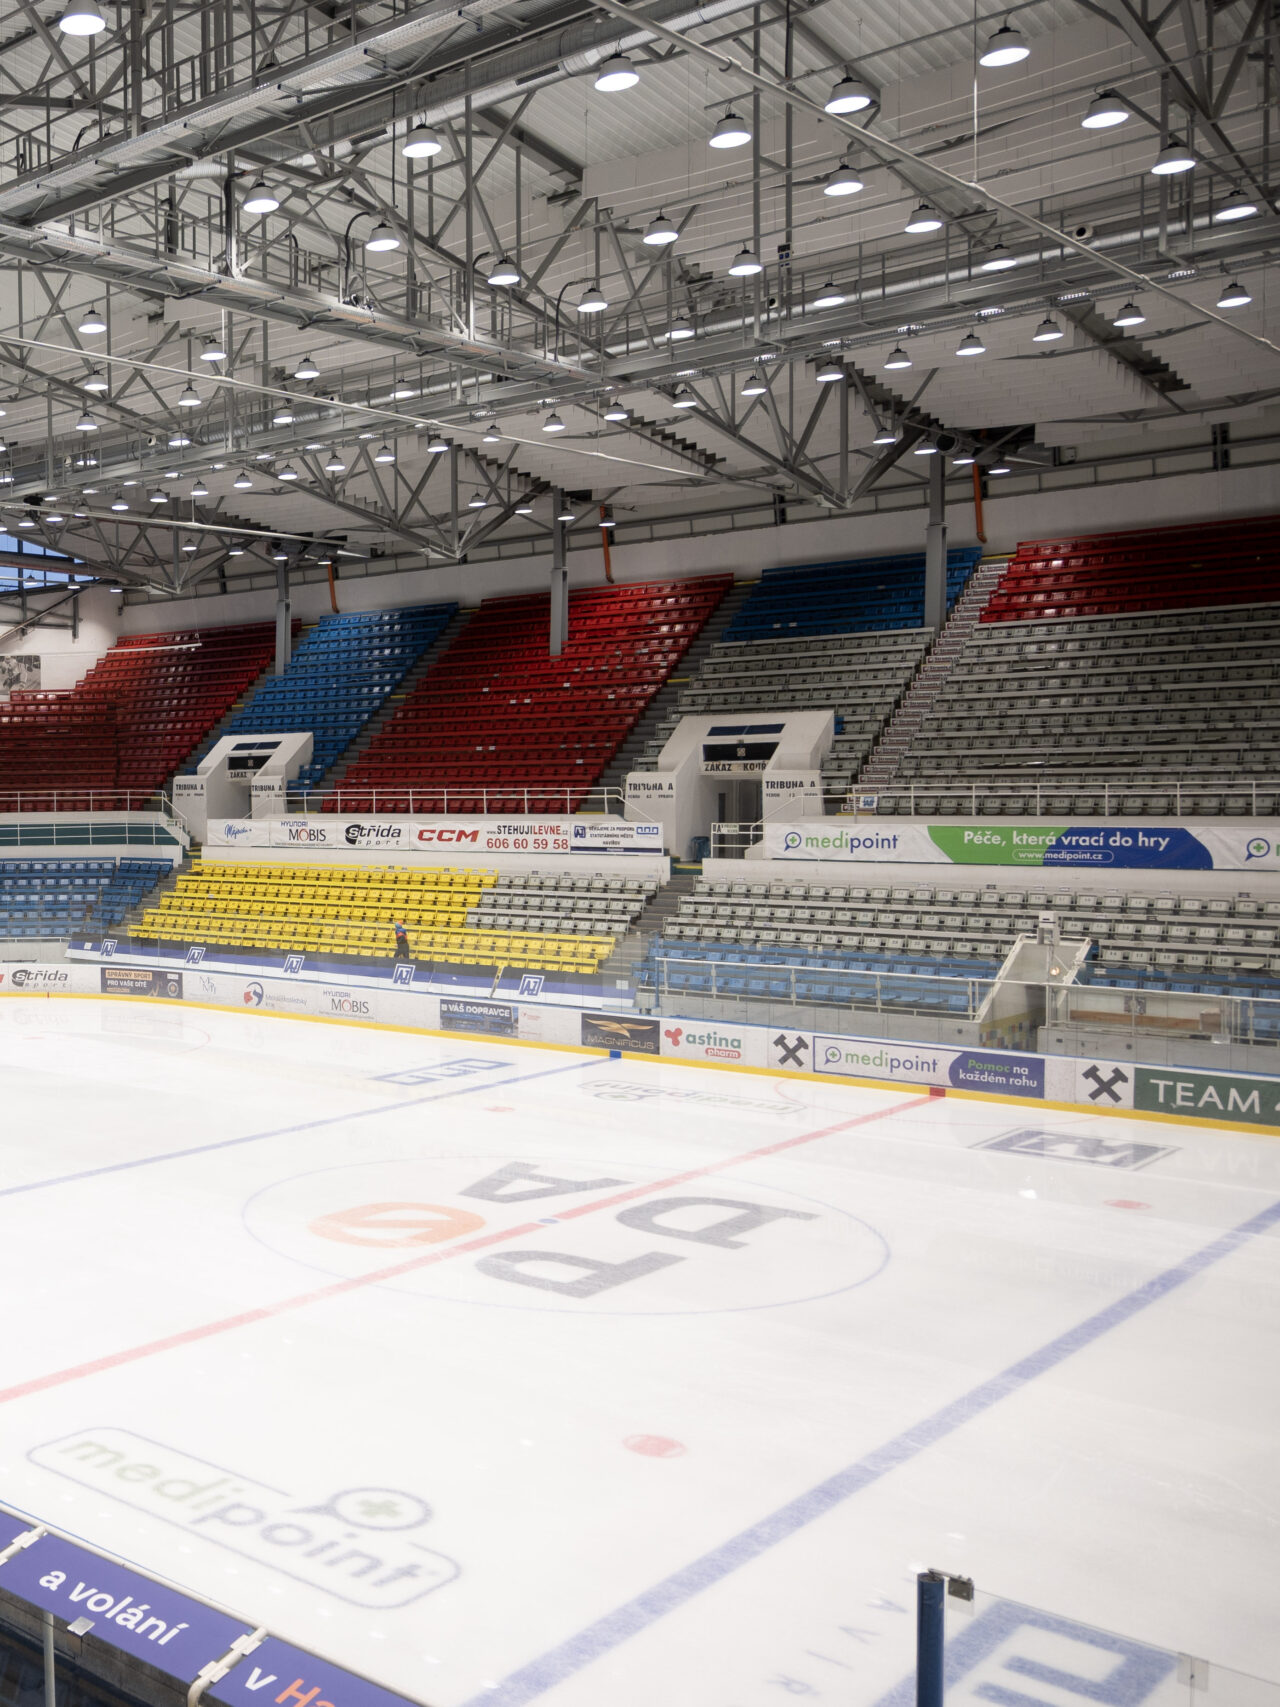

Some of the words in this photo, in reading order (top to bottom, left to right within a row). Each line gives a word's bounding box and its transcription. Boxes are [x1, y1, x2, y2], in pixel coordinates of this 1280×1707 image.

[176, 783, 198, 791] TRIBUNA
[200, 783, 204, 791] A
[252, 784, 275, 792] TRIBUNA
[278, 784, 283, 792] A
[629, 783, 663, 791] TRIBUNA
[668, 783, 674, 791] A
[766, 780, 804, 789] TRIBUNA
[810, 780, 816, 788] A
[289, 828, 326, 841] MOBIS
[418, 829, 479, 843] CCM
[805, 831, 899, 853] medipoint
[964, 831, 1006, 847] Péče,
[1012, 831, 1056, 845] která
[1061, 832, 1104, 846] vrací
[1109, 832, 1132, 847] do
[1137, 833, 1170, 850] hry
[486, 838, 509, 849] 606
[513, 839, 528, 849] 60
[533, 839, 548, 849] 59
[553, 839, 569, 849] 58
[1019, 850, 1103, 862] www.medipoint.cz
[331, 998, 370, 1014] MOBIS
[448, 1003, 464, 1012] VÁŠ
[466, 1005, 510, 1017] DOPRAVCE
[587, 1034, 654, 1050] MAGNIFICUS
[686, 1031, 742, 1049] astina
[707, 1047, 738, 1060] pharm
[845, 1050, 939, 1074] medipoint
[968, 1059, 1011, 1073] Pomoc
[1013, 1065, 1029, 1075] na
[959, 1068, 1006, 1085] každém
[1009, 1075, 1038, 1088] rohu
[1149, 1078, 1261, 1115] TEAM
[59, 1440, 428, 1588] medipoint
[38, 1569, 68, 1591] a
[67, 1583, 190, 1646] volání
[244, 1666, 278, 1692] v
